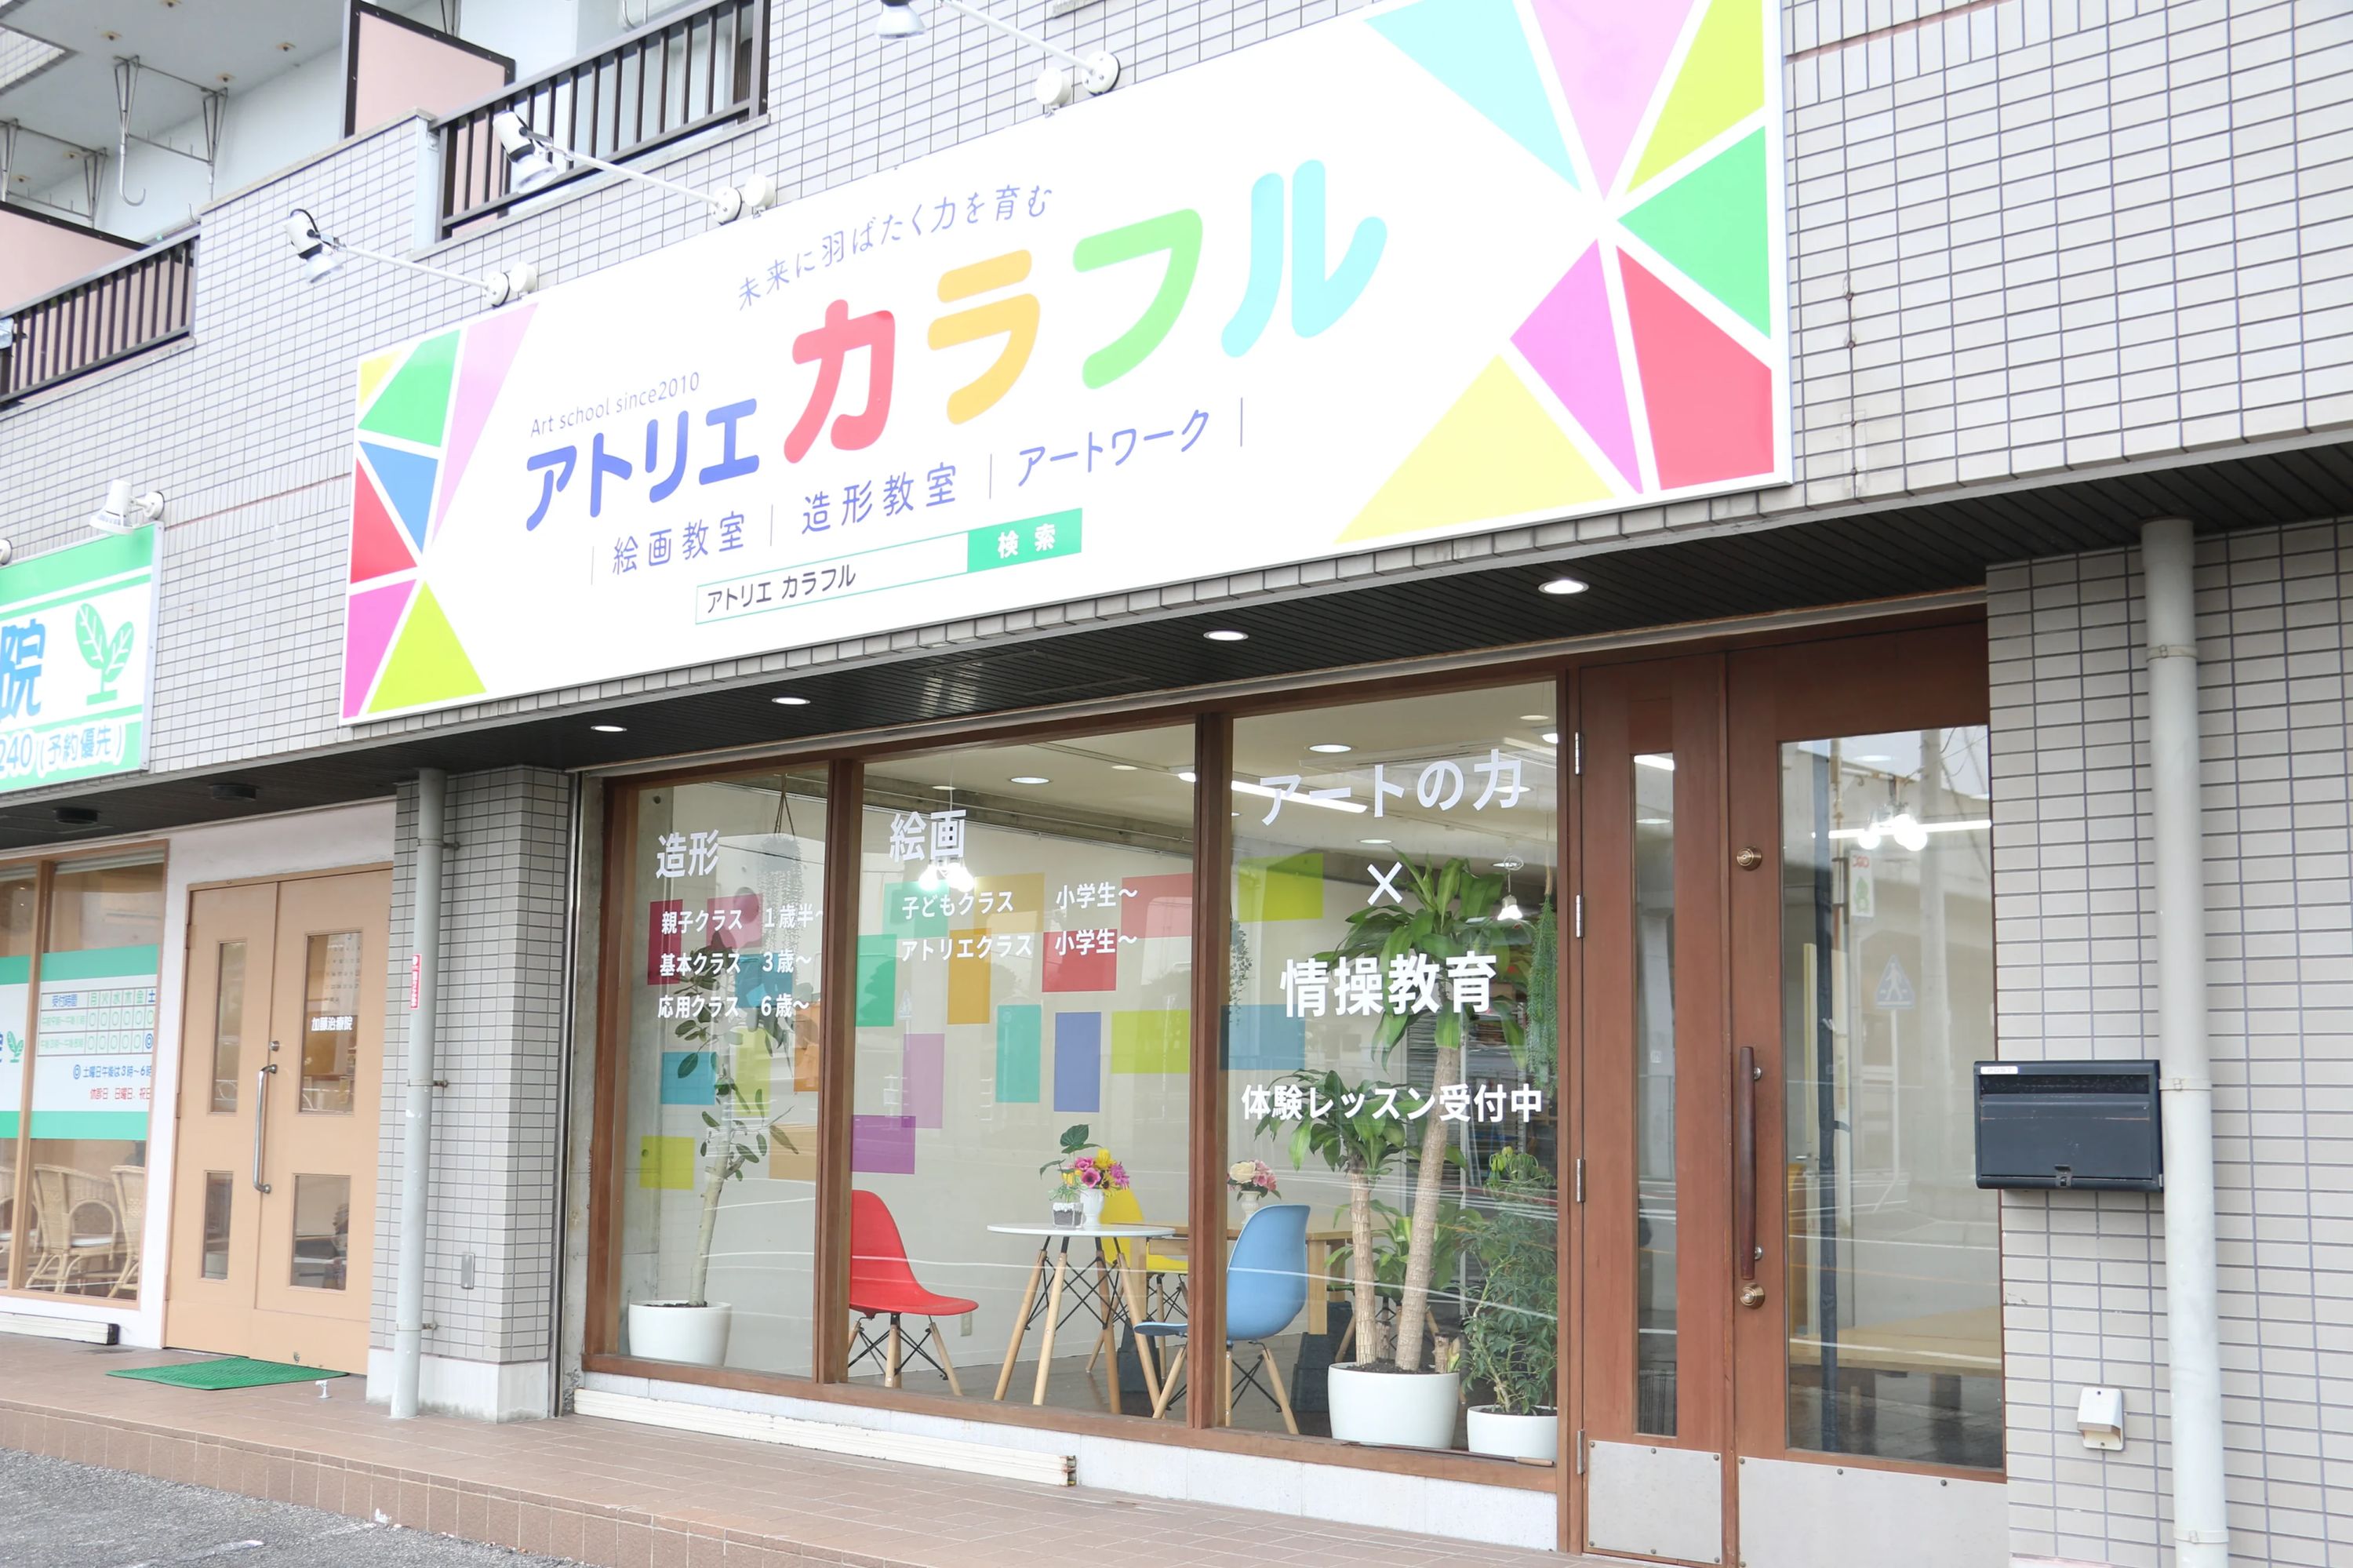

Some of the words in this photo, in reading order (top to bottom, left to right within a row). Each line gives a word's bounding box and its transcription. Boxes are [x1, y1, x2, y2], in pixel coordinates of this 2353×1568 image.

[739, 184, 1052, 311] 未来に羽ばたく力を育む
[526, 398, 759, 531] アトリエ
[784, 159, 1387, 464] カラフル
[530, 415, 554, 438] Art
[559, 398, 609, 429] school
[616, 372, 700, 413] since2010
[613, 511, 744, 575] 絵画教室
[802, 462, 956, 534] 造形教室
[1018, 409, 1209, 487] アートワーク
[997, 523, 1056, 559] 検索
[707, 581, 772, 613] アトリエ
[782, 564, 856, 600] カラフル
[0, 618, 45, 722] 院
[1260, 748, 1522, 825] アートの力
[656, 829, 719, 879] 造形
[889, 809, 966, 863] 絵画
[661, 910, 743, 934] 親子クラス
[902, 891, 1014, 920] 子どもクラス
[660, 952, 740, 977] 基本クラス
[902, 934, 1033, 962] アトリエクラス
[148, 989, 156, 1003] 土
[658, 995, 739, 1018] 応用クラス
[1279, 951, 1497, 1018] 情操教育
[1241, 1083, 1542, 1122] 体験レッスン受付中
